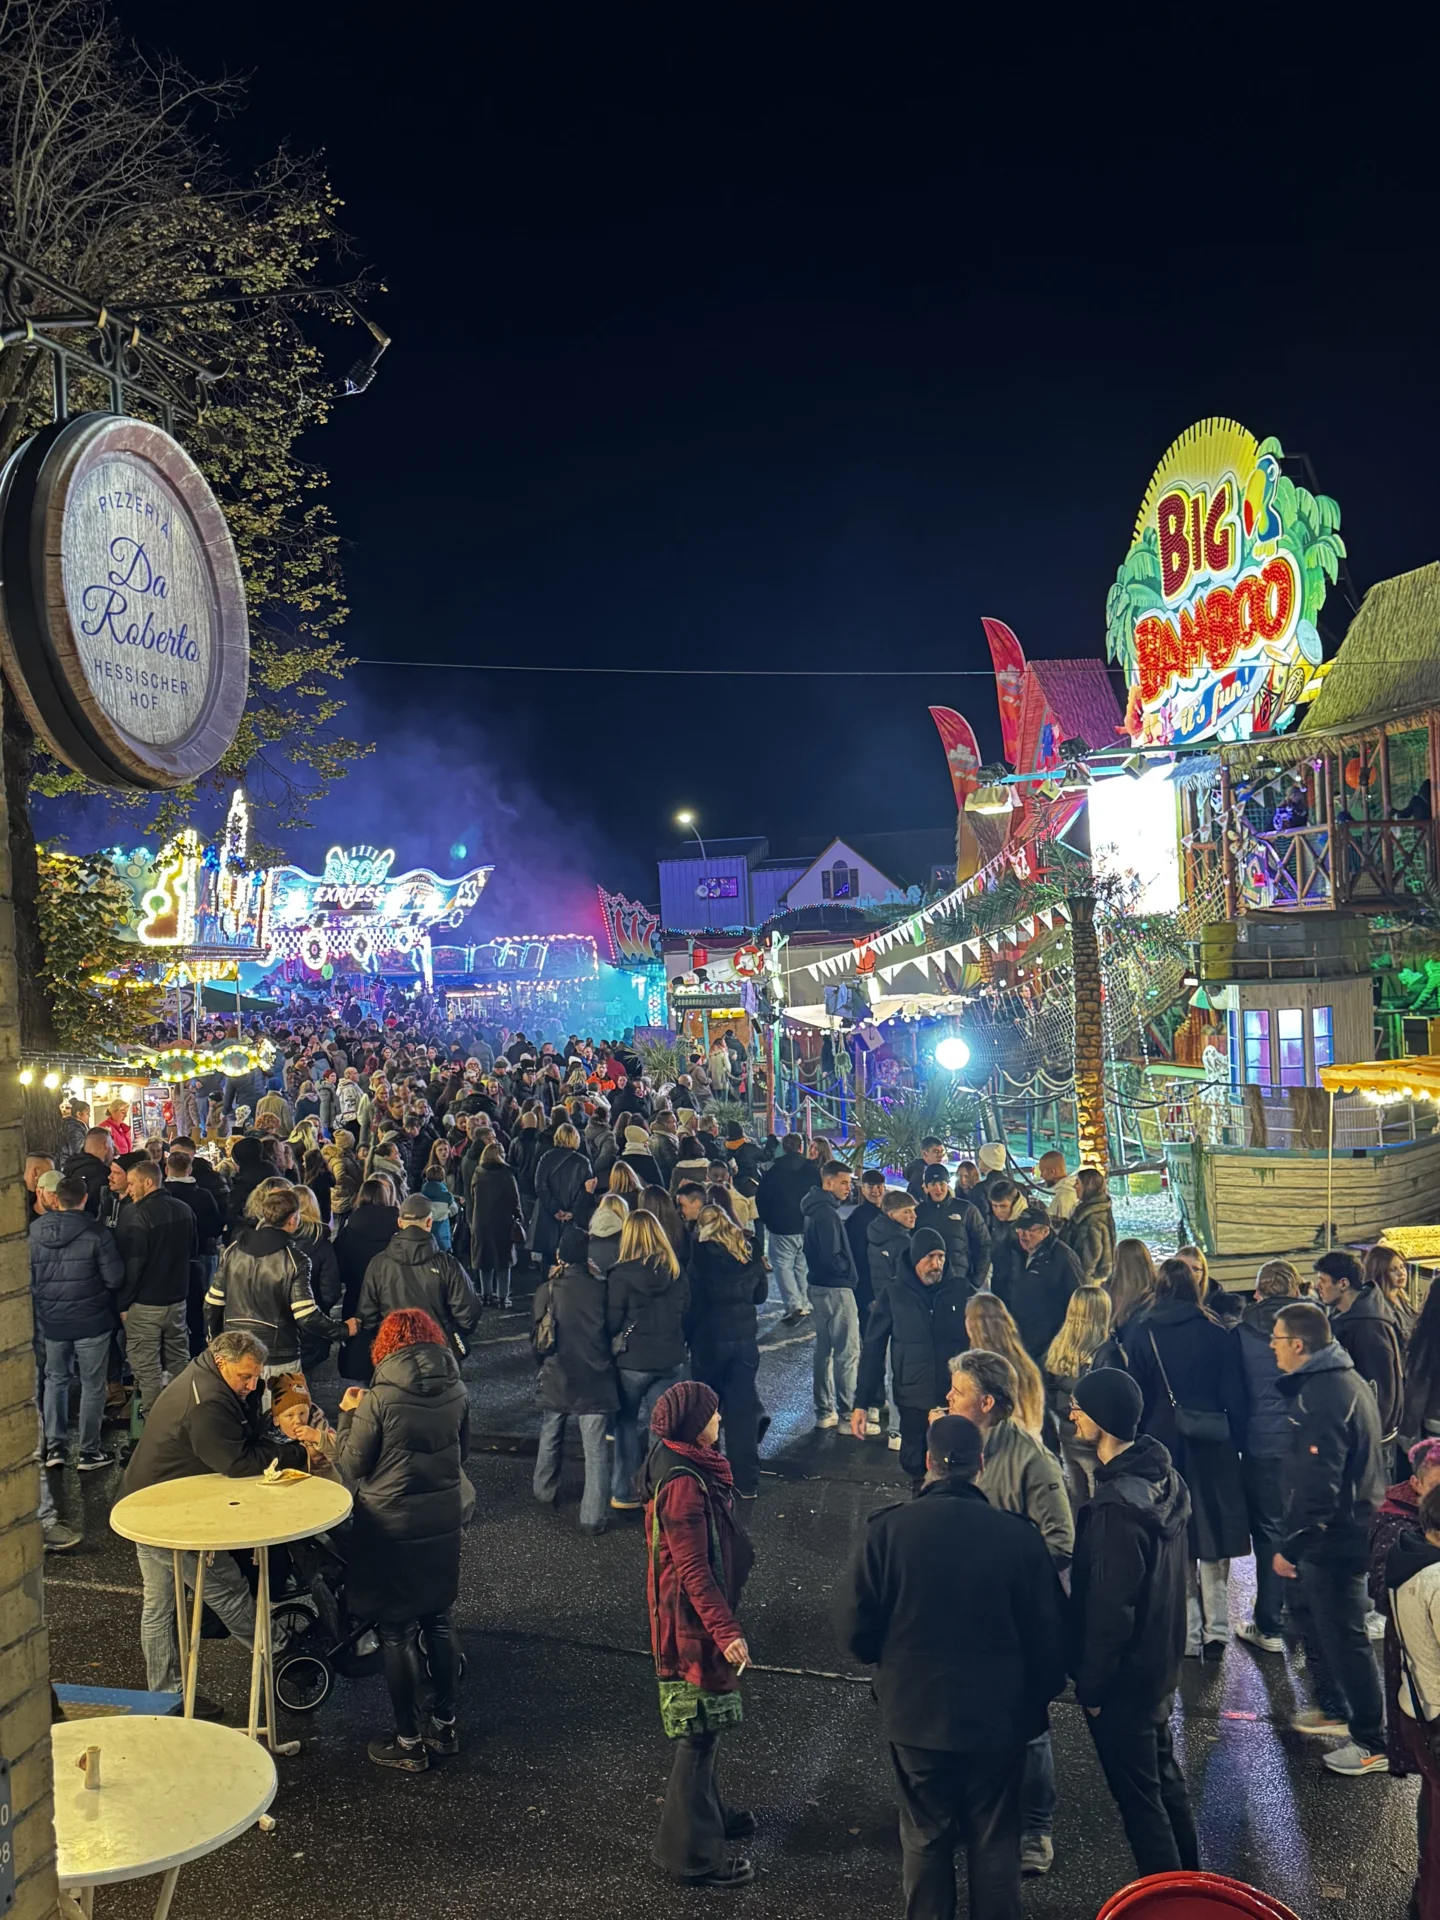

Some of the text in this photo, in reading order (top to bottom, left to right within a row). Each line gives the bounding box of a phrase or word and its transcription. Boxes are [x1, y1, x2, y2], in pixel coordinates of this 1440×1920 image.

[99, 491, 170, 539] PIZZERIA
[1157, 481, 1234, 599] BIG
[108, 536, 169, 600] Da
[81, 585, 201, 663] Roberto
[1135, 557, 1295, 706] BAMBOO
[94, 658, 190, 697] HESSISCHER
[129, 690, 160, 712] HOF
[1211, 667, 1249, 727] fun!
[312, 885, 386, 909] EXPRESS
